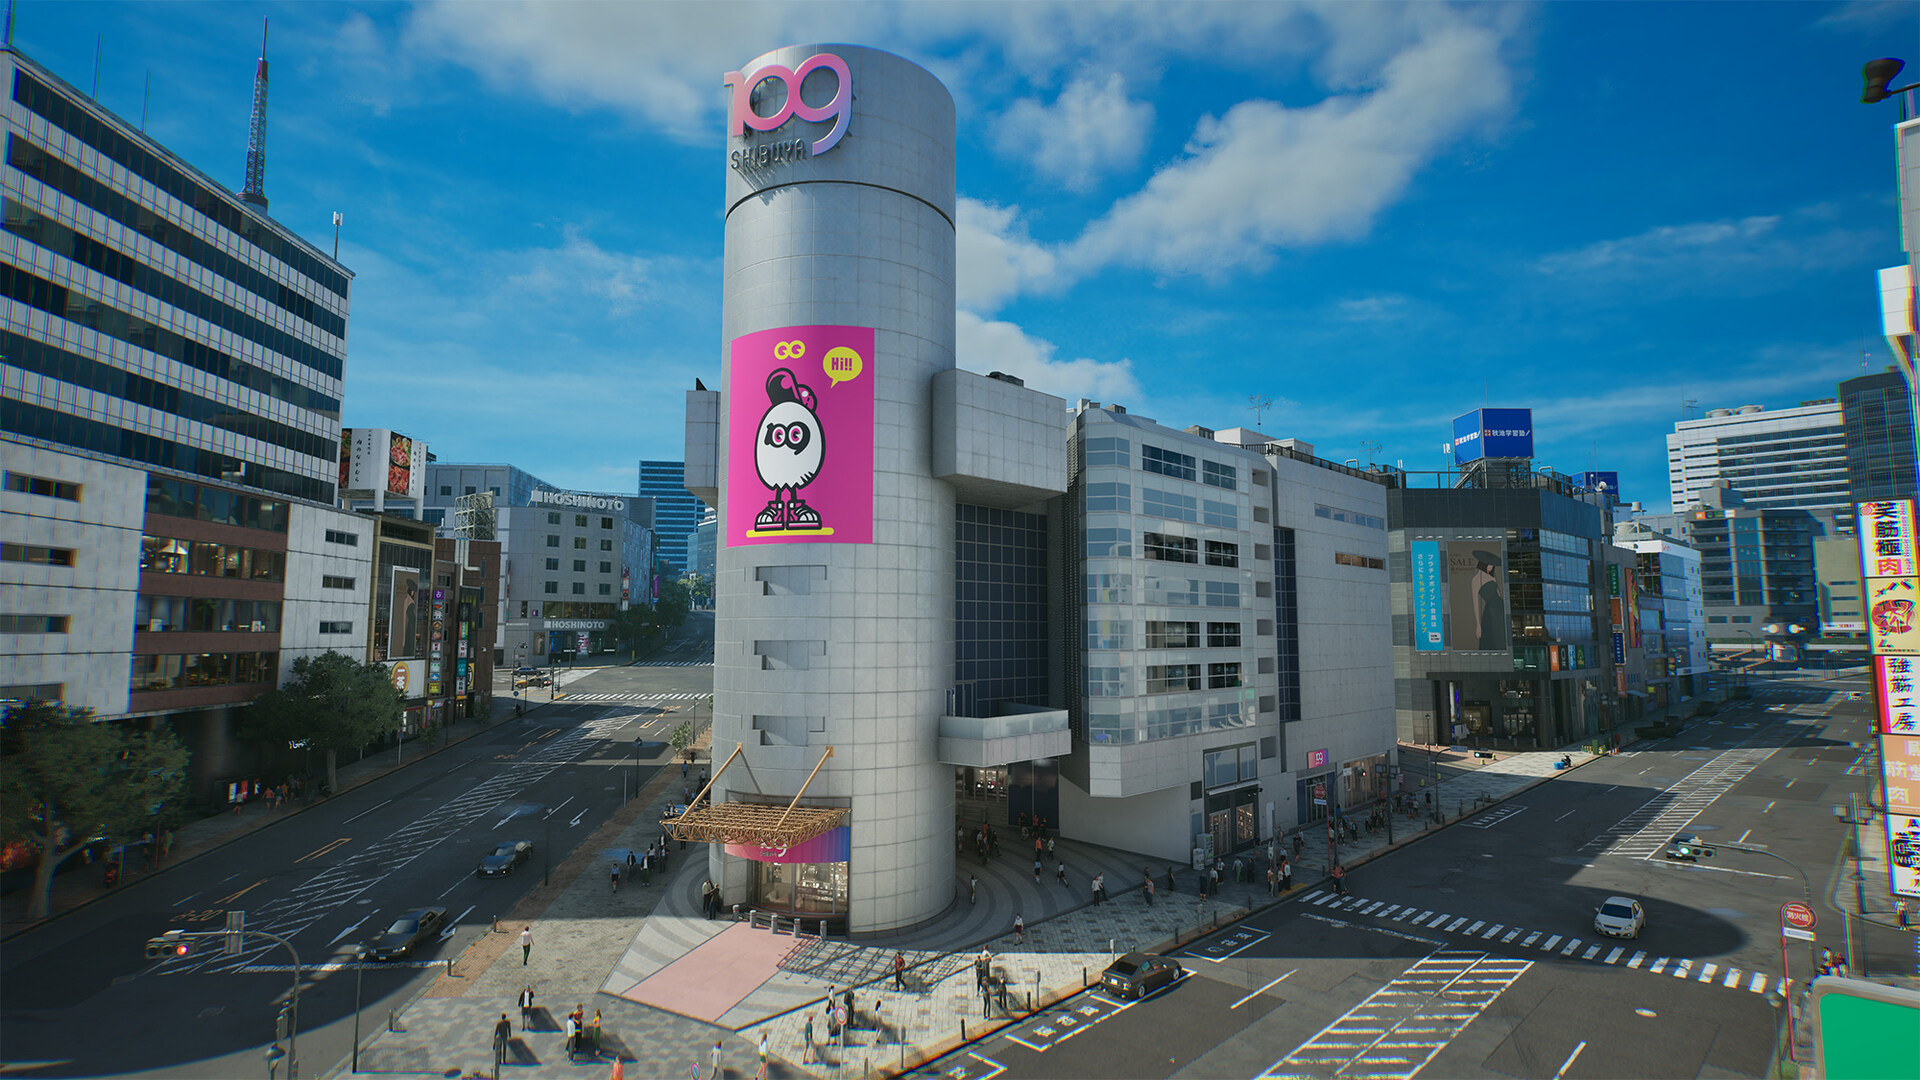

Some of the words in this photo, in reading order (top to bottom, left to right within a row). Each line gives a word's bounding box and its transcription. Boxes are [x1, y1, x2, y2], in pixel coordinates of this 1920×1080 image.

[724, 53, 852, 156] 109
[731, 138, 807, 170] SHIBUYA
[831, 357, 853, 371] Hi!!
[544, 493, 625, 511] HOSHINOTO
[1450, 557, 1475, 566] SALE
[552, 620, 605, 629] HOSHINOTO
